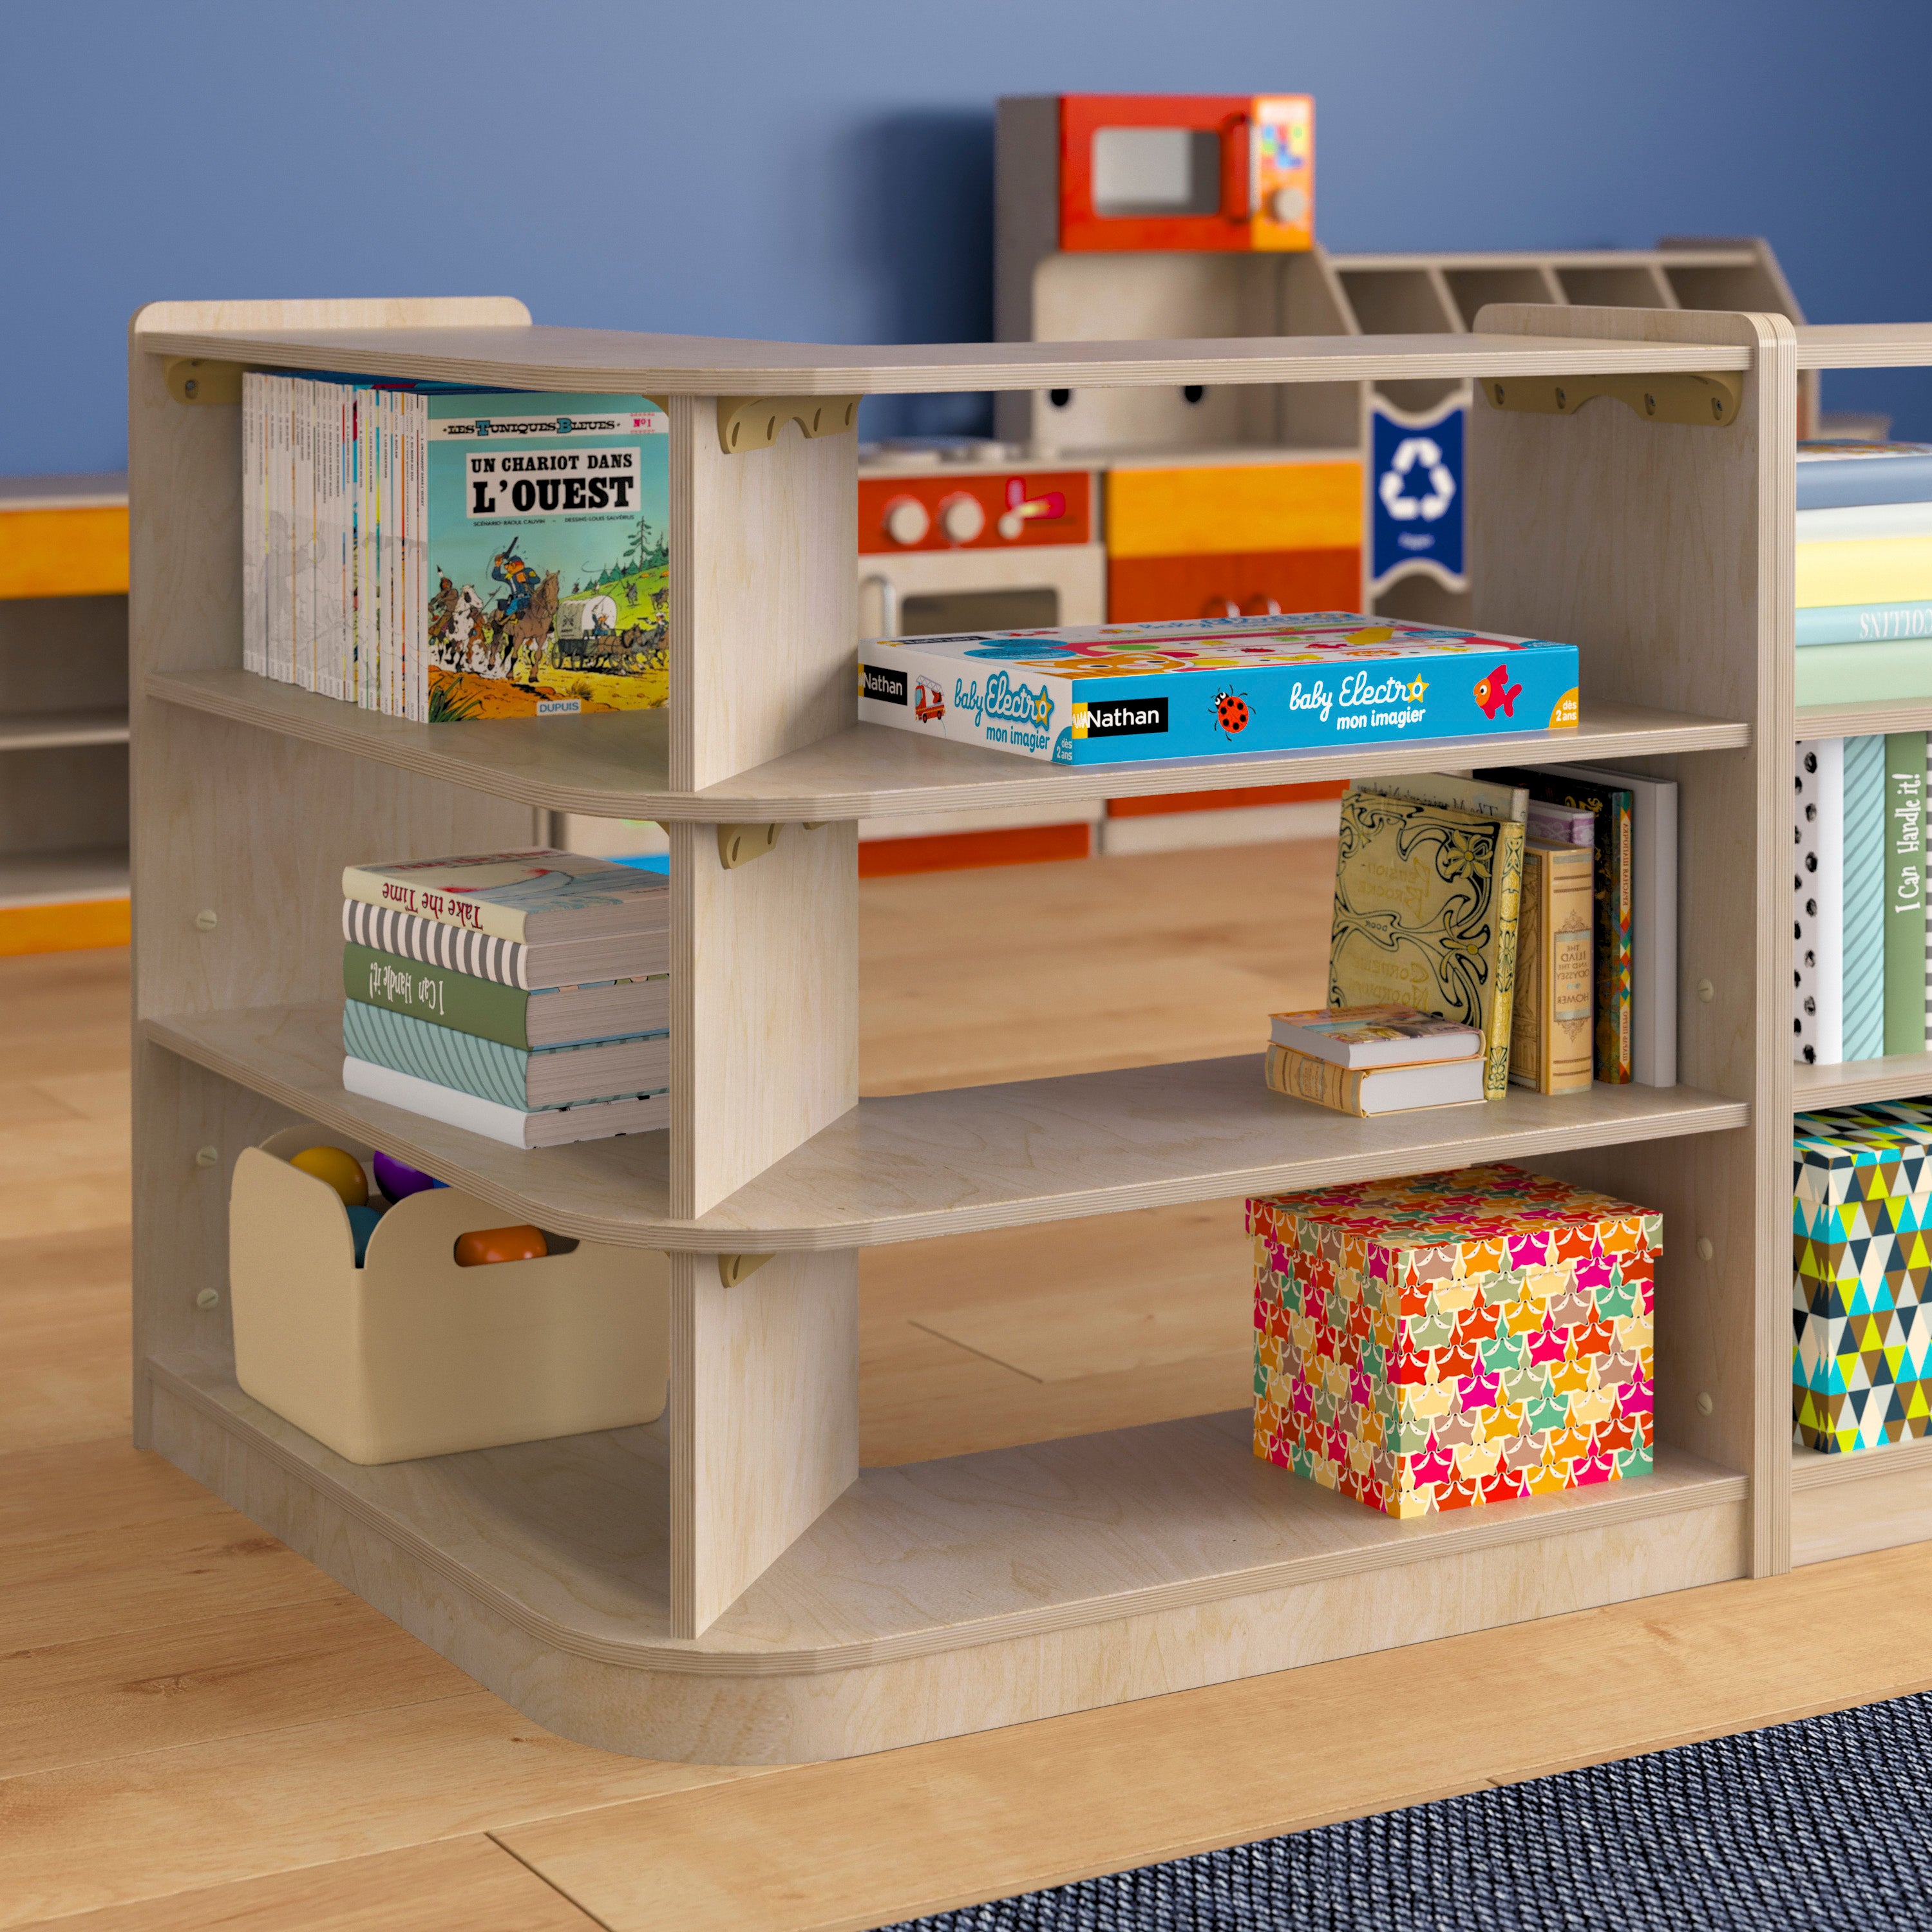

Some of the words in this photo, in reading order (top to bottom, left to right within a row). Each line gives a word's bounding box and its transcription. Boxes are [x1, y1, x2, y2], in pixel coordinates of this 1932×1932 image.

[448, 424, 475, 435] LES
[475, 420, 556, 436] TUNIQUES
[556, 417, 615, 433] BLEUES
[471, 458, 495, 473] UN
[502, 455, 580, 471] CHARIOT
[587, 453, 632, 469] DANS
[473, 476, 634, 514] L'OUEST
[863, 671, 903, 696] Nathan
[1290, 680, 1332, 723] baby
[1338, 670, 1425, 707] Electro
[539, 701, 580, 713] DUPUIS
[954, 677, 984, 728] baby
[986, 671, 1051, 726] Electro
[1562, 699, 1577, 712] dès
[1086, 707, 1160, 728] Nathan
[1336, 713, 1370, 730] mon
[1370, 705, 1426, 729] imagier
[1556, 710, 1563, 722] 2
[1562, 712, 1577, 722] ans
[986, 726, 1009, 744] mon
[1009, 724, 1050, 753] imagier
[1061, 737, 1073, 750] dès
[1056, 746, 1065, 759] 2
[1065, 750, 1073, 761] ans
[1891, 773, 1921, 795] it!
[1894, 798, 1922, 855] Handle
[1897, 865, 1920, 898] Can
[382, 882, 419, 914] Time
[422, 891, 444, 920] the
[1895, 902, 1921, 913] I
[448, 898, 484, 931] Take
[369, 961, 381, 999] it!
[383, 965, 412, 1004] Handle
[418, 976, 436, 1010] Can
[439, 980, 444, 1016] I
